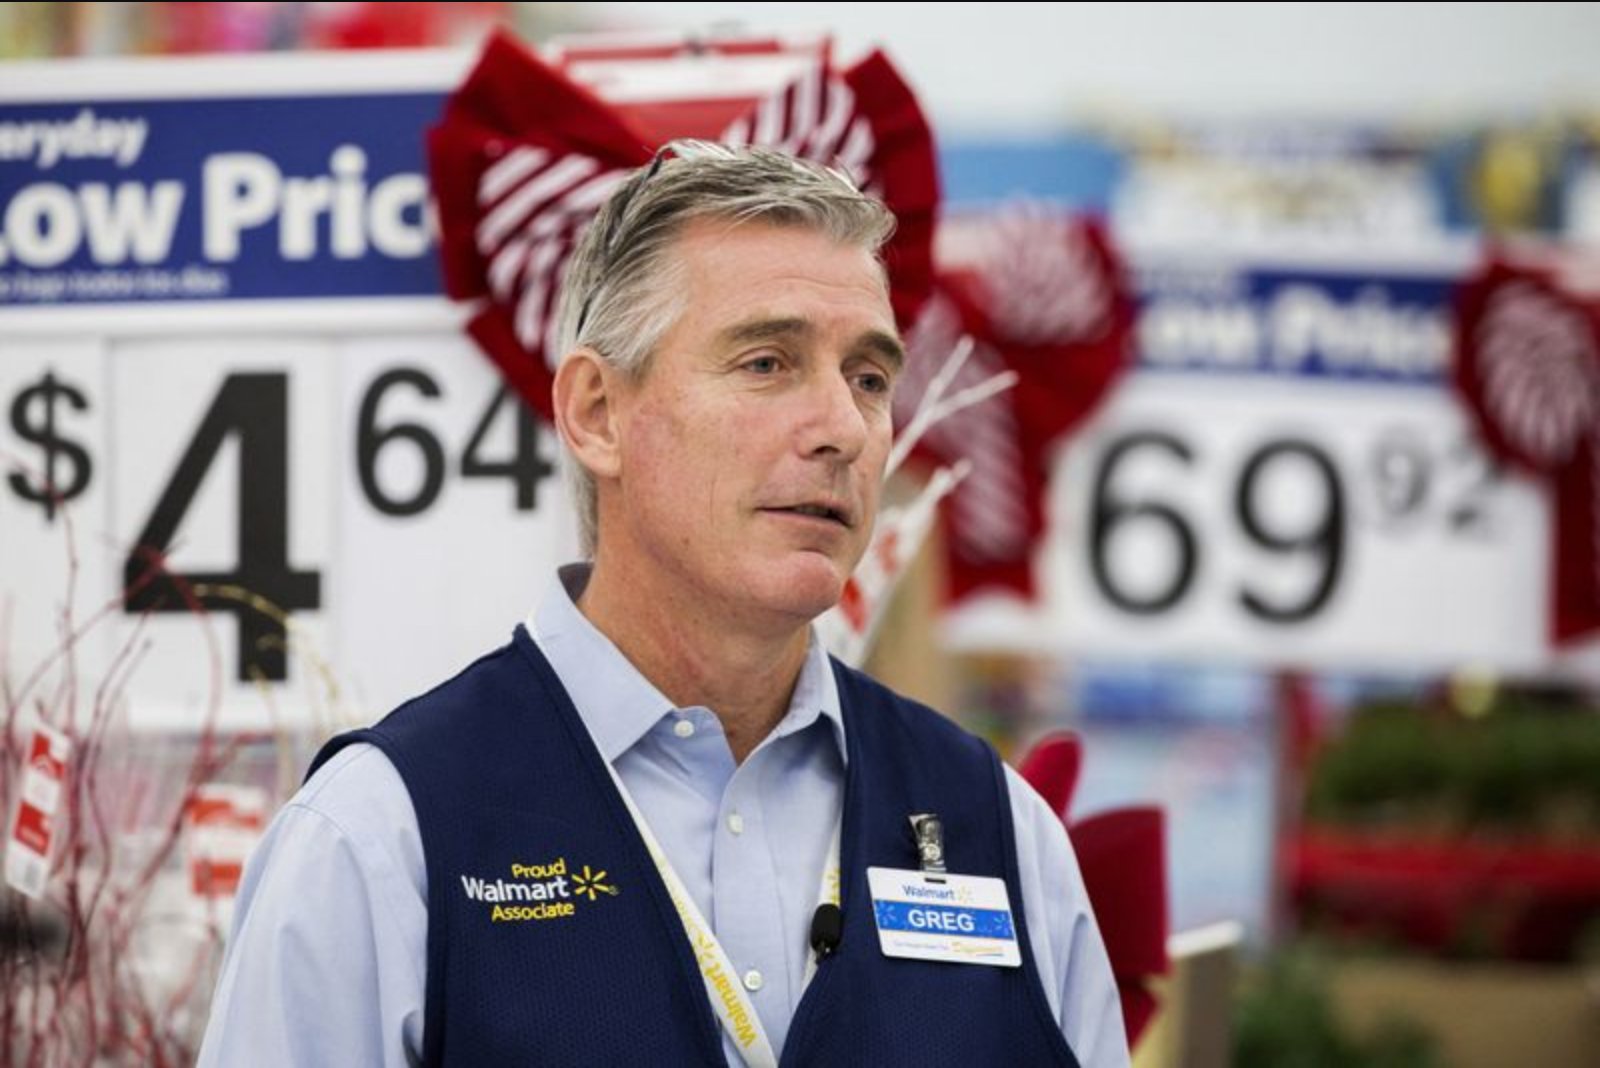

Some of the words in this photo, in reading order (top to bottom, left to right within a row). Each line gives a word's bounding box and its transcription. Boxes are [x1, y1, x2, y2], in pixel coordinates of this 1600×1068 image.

[1087, 428, 1346, 626] 69
[511, 858, 567, 879] Proud
[460, 874, 571, 903] Walmart
[902, 884, 956, 901] Walmart
[490, 902, 575, 922] Associate
[908, 909, 975, 932] GREG
[704, 961, 757, 1048] Walmart
